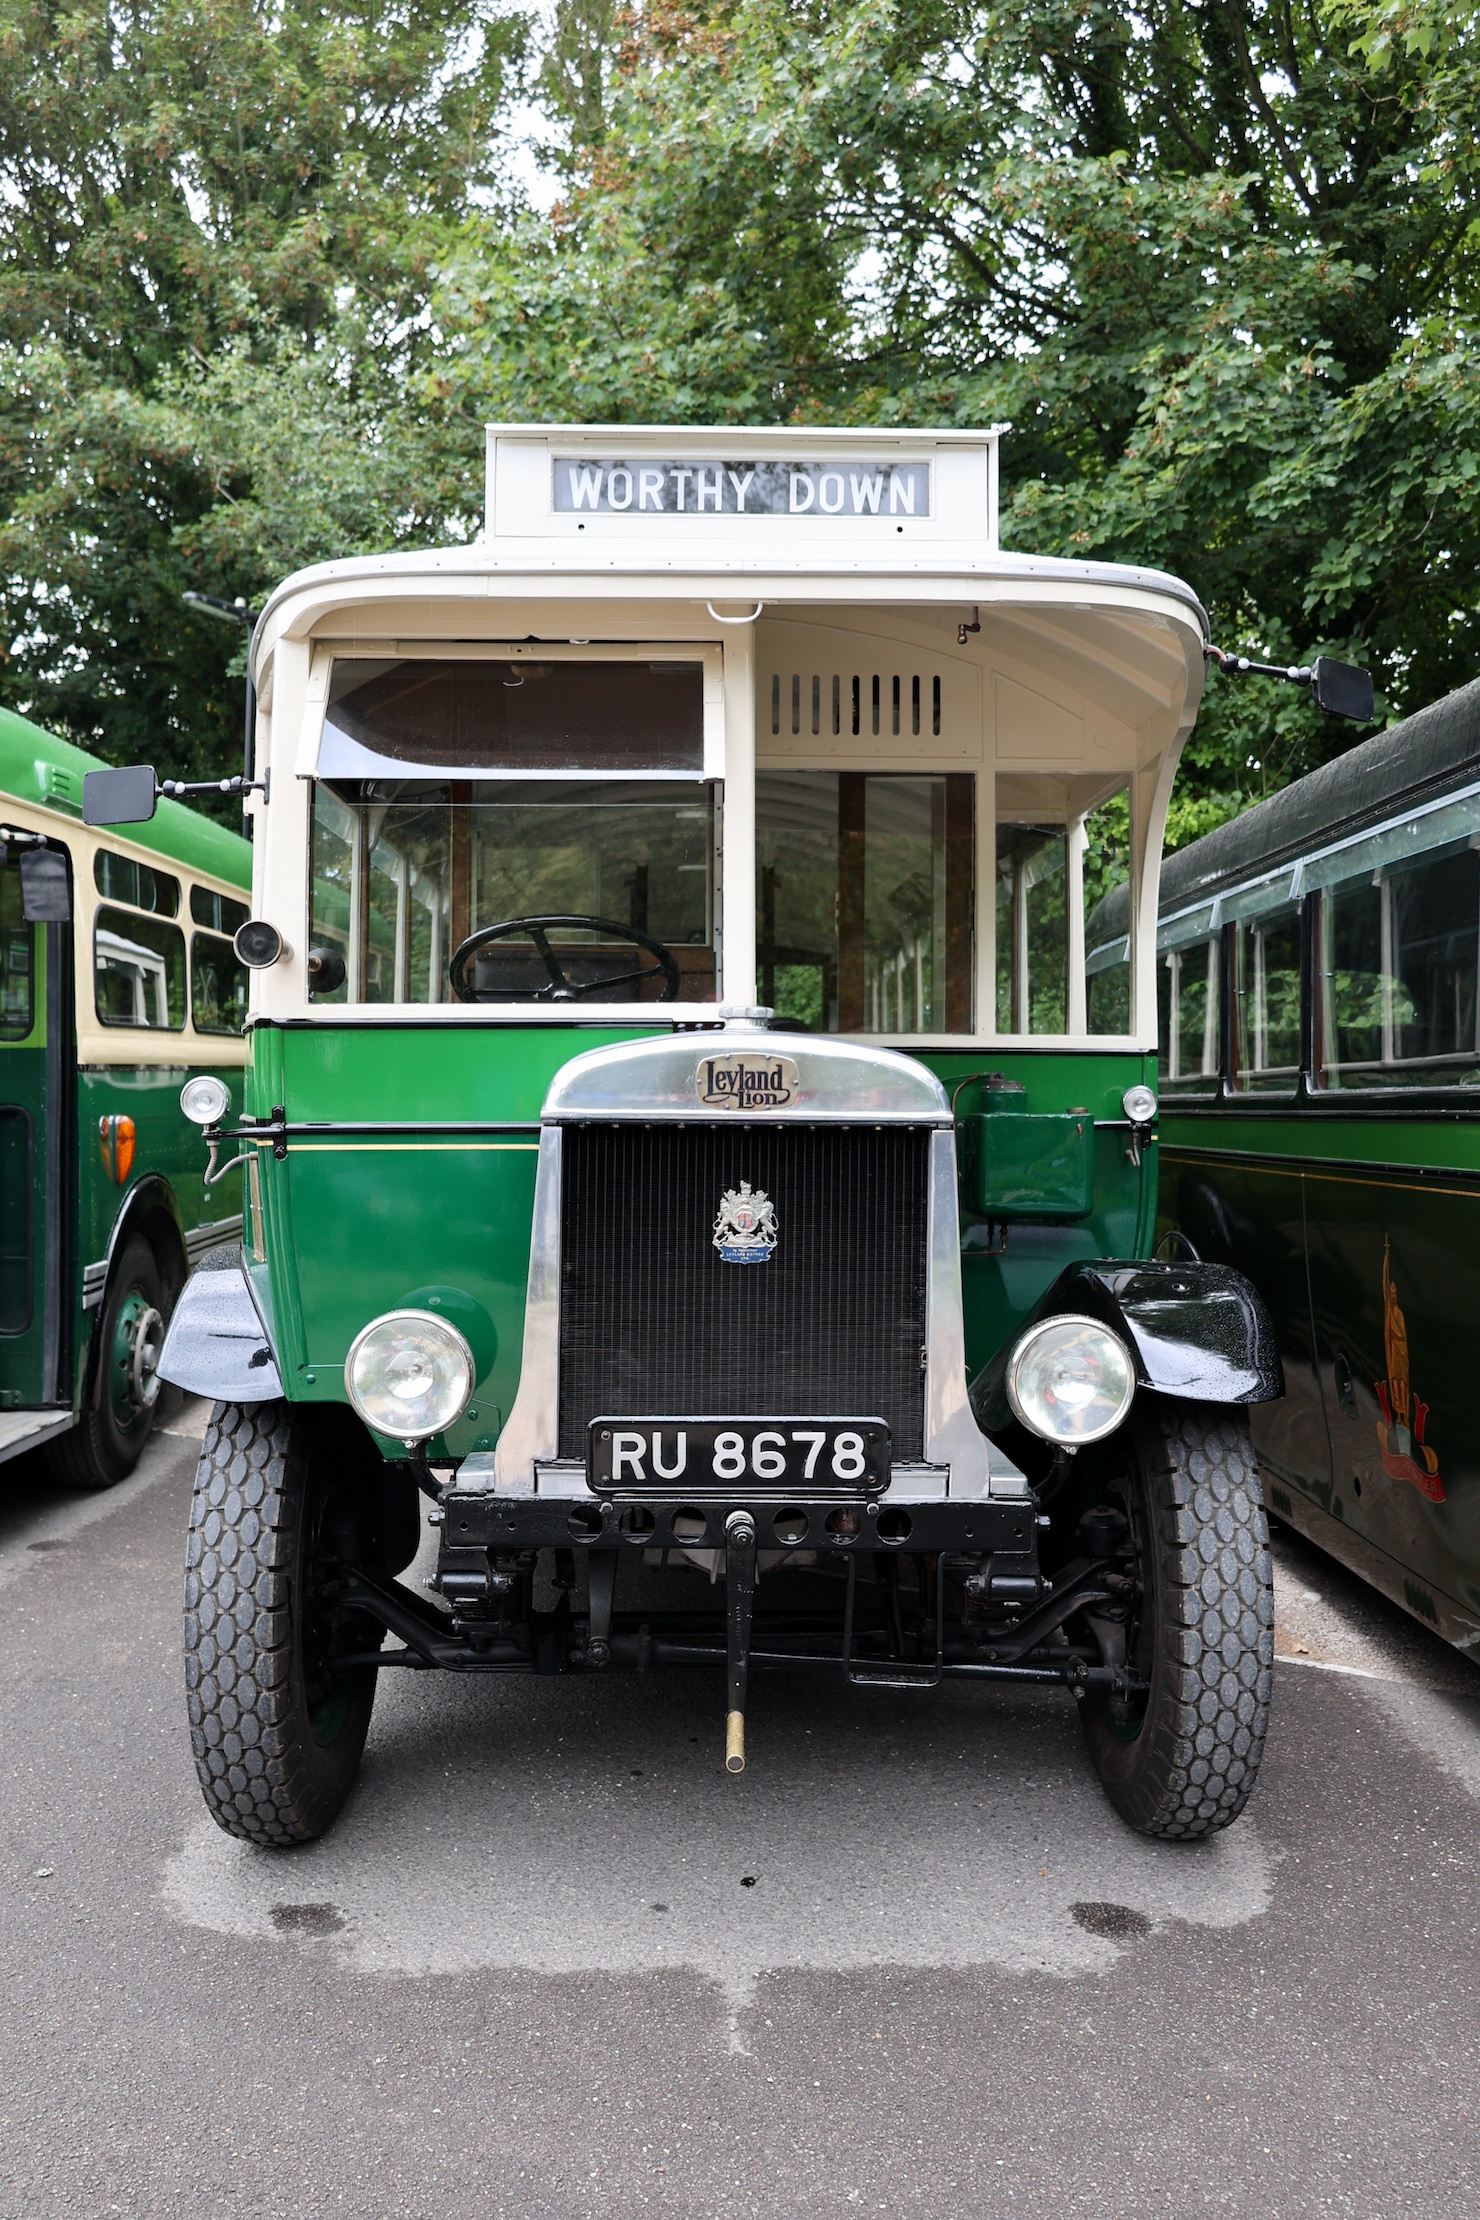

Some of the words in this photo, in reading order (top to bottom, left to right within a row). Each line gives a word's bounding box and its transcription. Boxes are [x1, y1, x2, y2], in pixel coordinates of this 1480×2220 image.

[569, 468, 755, 512] WORTHY
[788, 471, 915, 514] DOWN
[703, 1061, 790, 1103] Leyland
[737, 1090, 778, 1108] Lion
[612, 1431, 687, 1480] RU
[712, 1431, 866, 1480] 8678
